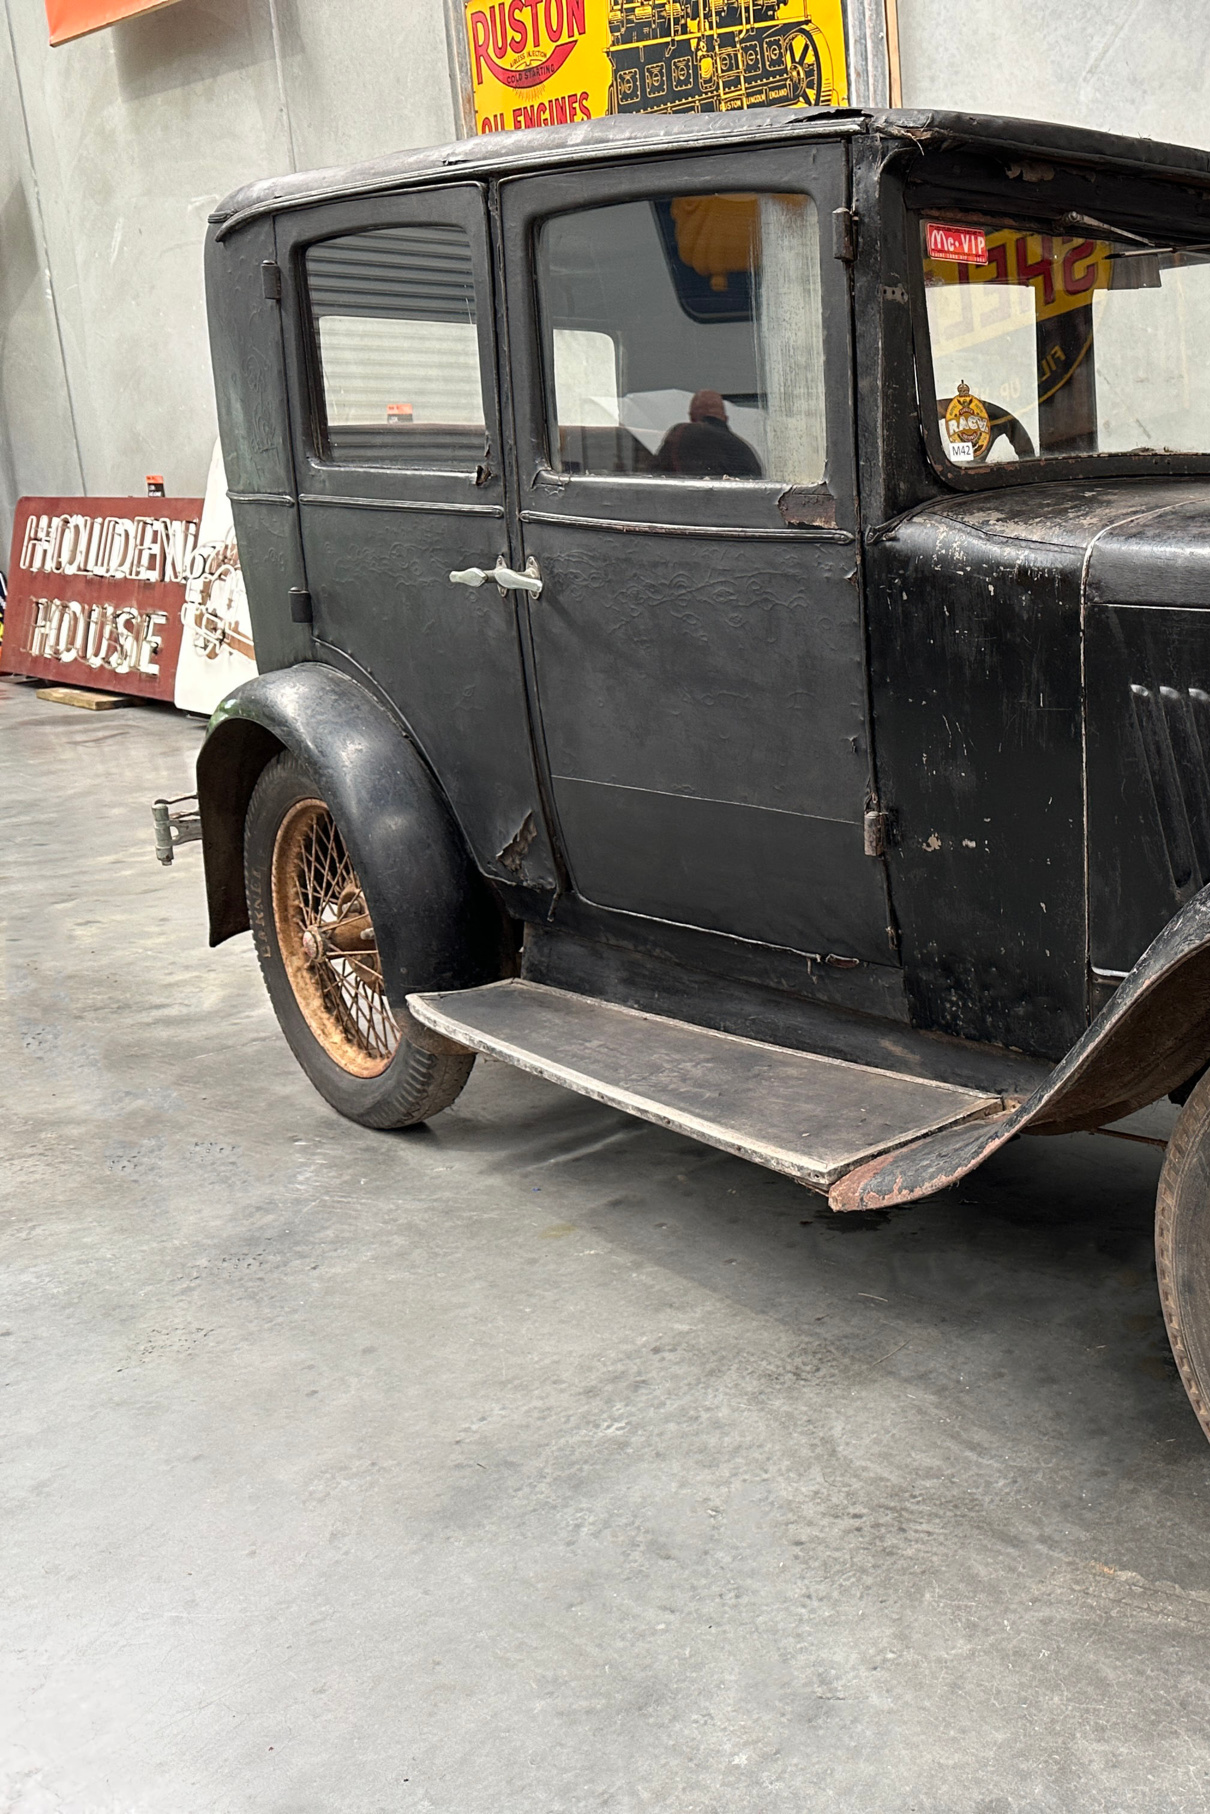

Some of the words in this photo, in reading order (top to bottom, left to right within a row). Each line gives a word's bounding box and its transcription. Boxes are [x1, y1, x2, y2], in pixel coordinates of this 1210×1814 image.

[470, 0, 586, 86] RUSTON
[506, 72, 523, 84] COLD
[524, 63, 555, 80] STARTING
[512, 91, 592, 130] ENGINES
[769, 88, 788, 99] ENGLAND
[952, 445, 972, 456] M42
[20, 513, 199, 584] HOLDEN
[30, 598, 168, 676] HOUSE
